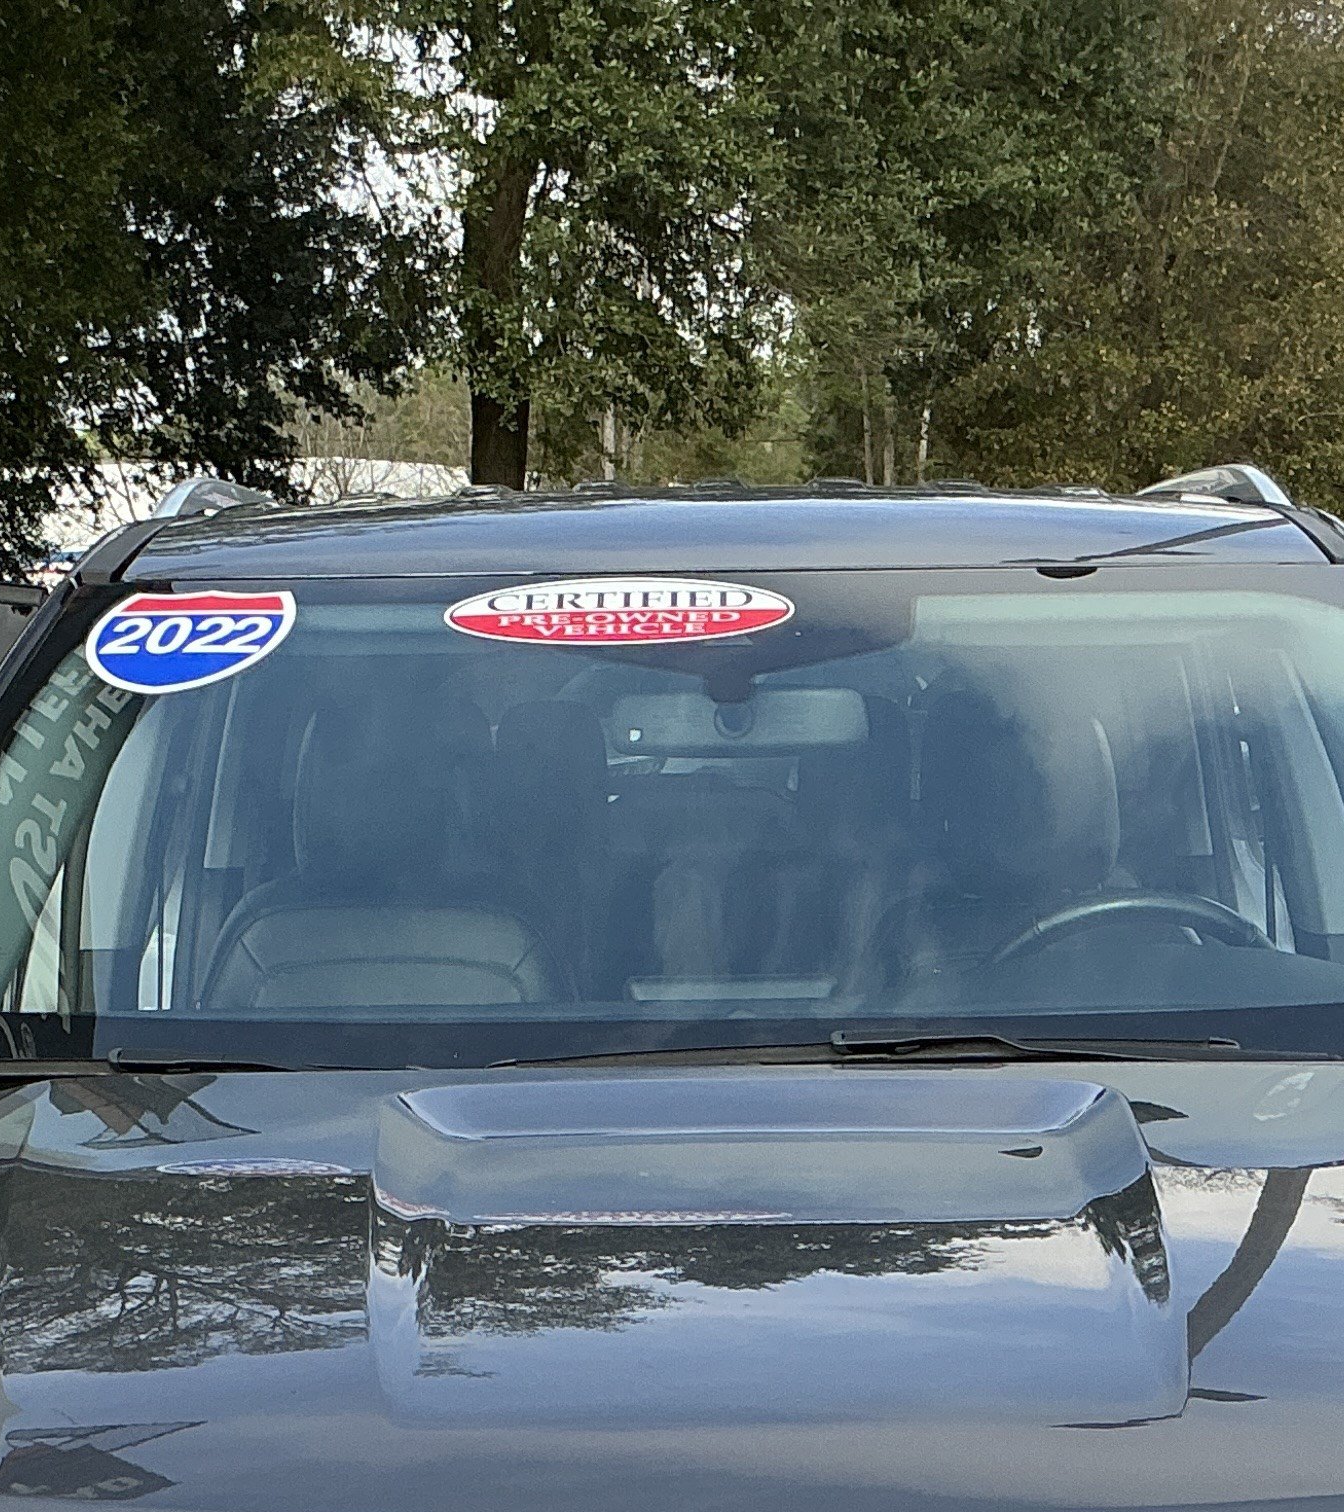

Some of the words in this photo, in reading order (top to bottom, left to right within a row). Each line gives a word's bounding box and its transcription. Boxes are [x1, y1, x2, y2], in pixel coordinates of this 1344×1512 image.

[487, 590, 753, 613] CERTIFIED
[498, 611, 741, 627] PRE-OWNED
[99, 616, 273, 655] 2022
[534, 622, 707, 637] VEHICLE
